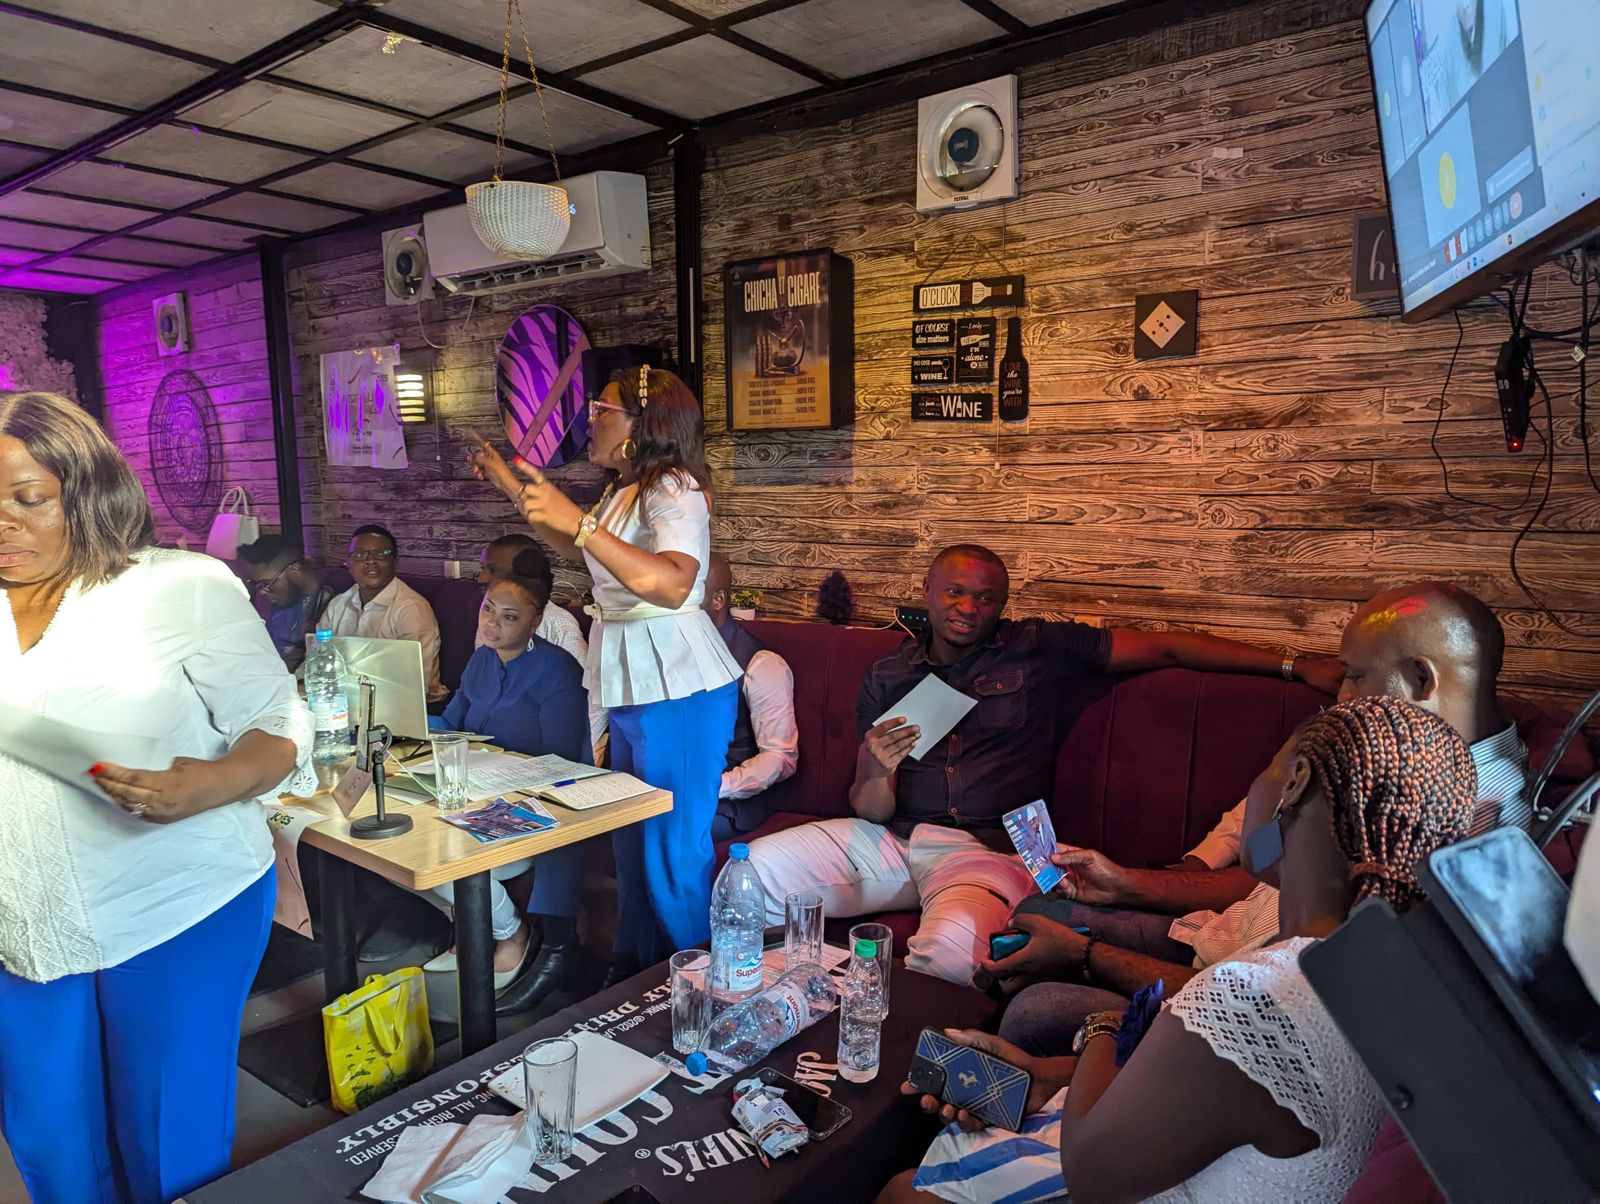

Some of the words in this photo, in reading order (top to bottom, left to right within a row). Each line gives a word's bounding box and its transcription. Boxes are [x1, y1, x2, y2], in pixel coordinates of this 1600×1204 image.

[744, 277, 778, 312] CHICHA
[787, 271, 821, 308] CIGARE
[922, 285, 960, 307] O'CLOCK
[915, 324, 925, 334] OF
[925, 322, 950, 333] COURSE
[920, 372, 943, 380] WINE
[335, 1053, 527, 1154] ESPONSIBLY.
[452, 1099, 476, 1115] ALL
[772, 1107, 786, 1117] 10
[344, 1133, 401, 1166] ESERVED.
